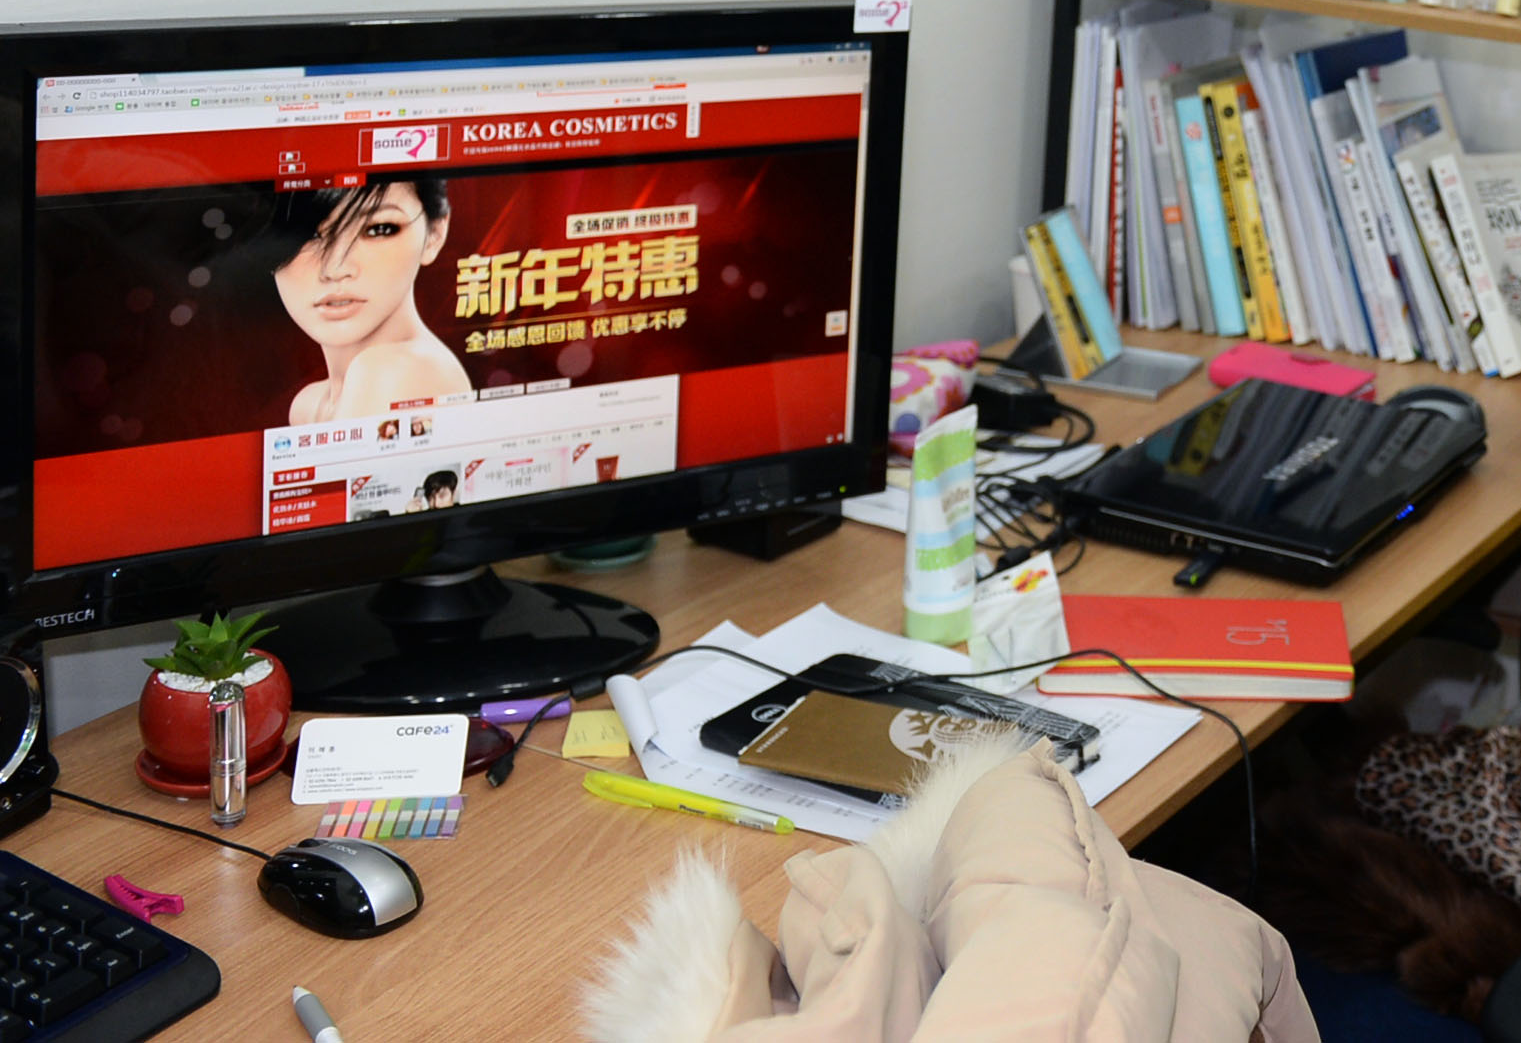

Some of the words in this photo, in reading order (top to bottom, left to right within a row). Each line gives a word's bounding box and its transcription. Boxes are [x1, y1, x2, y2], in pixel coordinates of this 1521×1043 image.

[374, 137, 412, 149] some
[462, 121, 543, 143] KOREA
[549, 112, 678, 137] COSMETICS
[455, 235, 700, 319] 新年特惠
